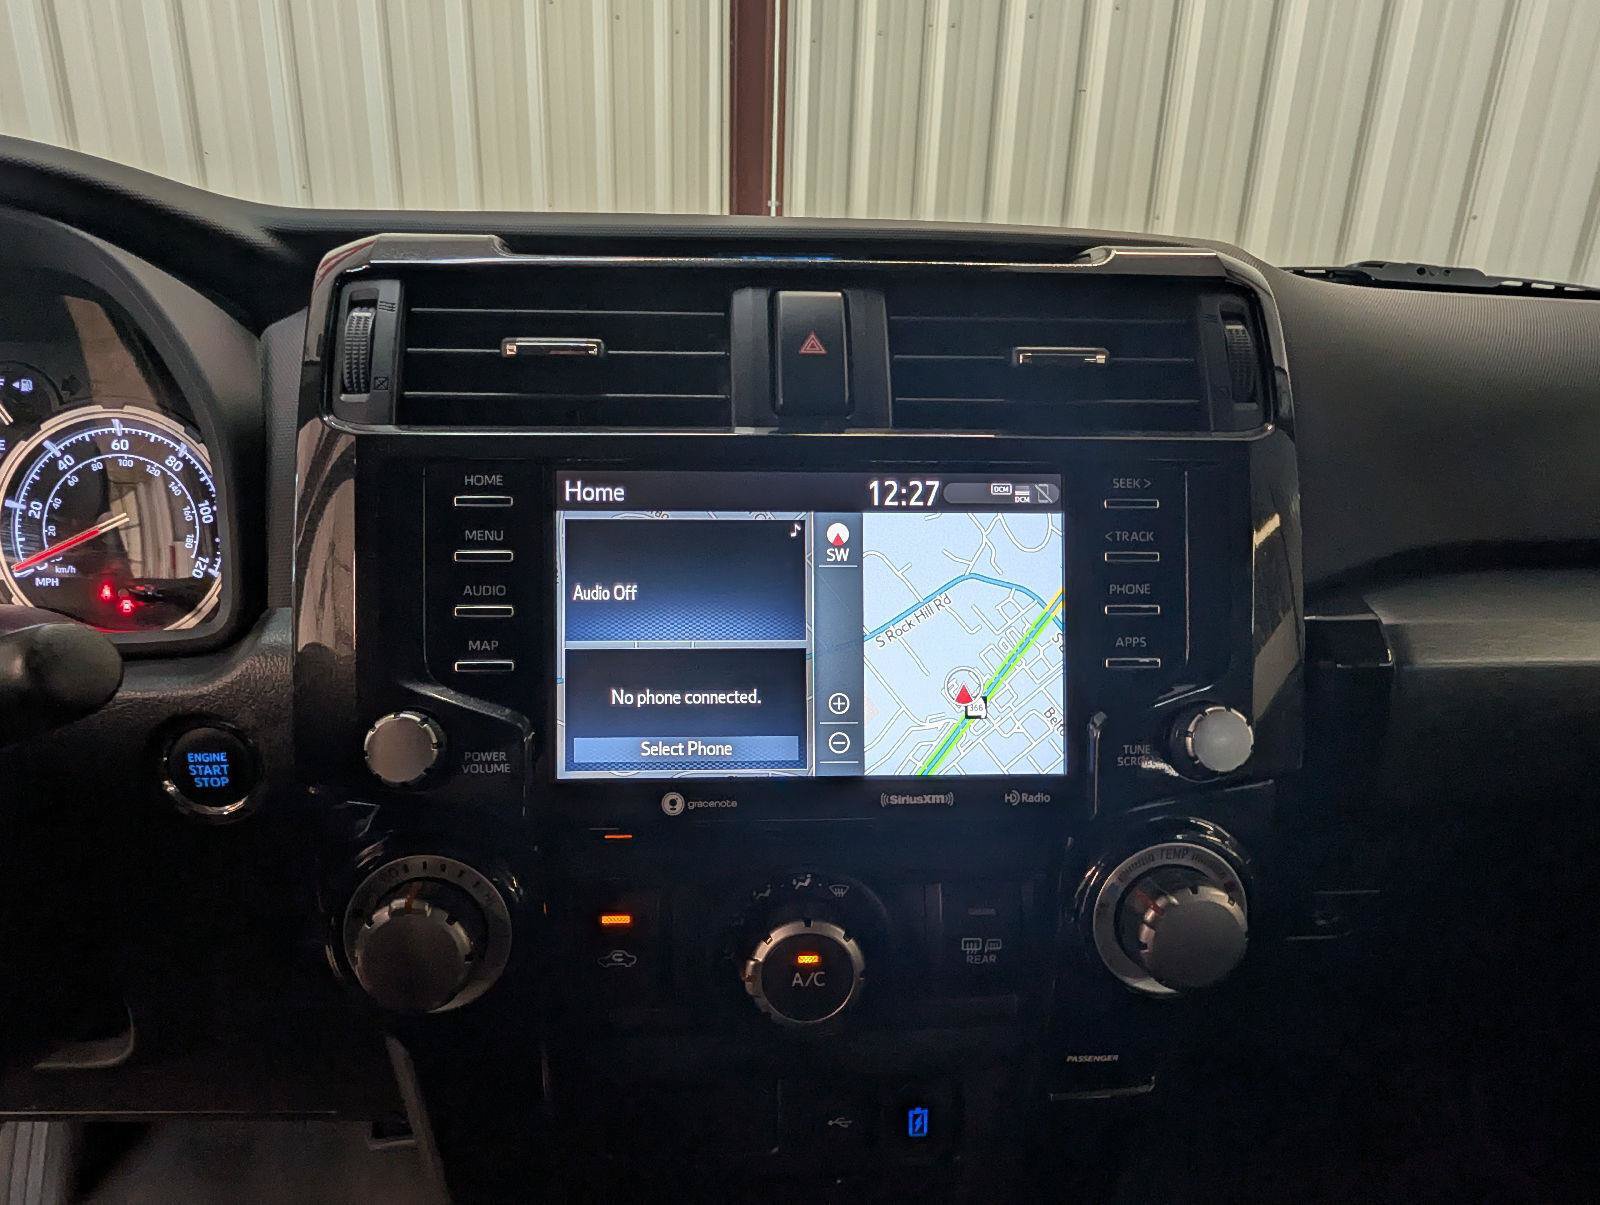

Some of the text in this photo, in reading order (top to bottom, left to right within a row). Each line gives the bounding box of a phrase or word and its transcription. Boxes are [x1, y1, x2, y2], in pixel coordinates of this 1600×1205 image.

[110, 439, 131, 452] 60
[57, 454, 75, 472] 40
[91, 461, 104, 472] 80
[118, 458, 134, 469] 100
[164, 455, 184, 473] 80
[145, 464, 162, 478] 120
[67, 475, 79, 488] 60
[464, 475, 504, 486] HOME
[1112, 478, 1141, 489] SEEK
[168, 480, 182, 497] 140
[564, 480, 625, 503] Home
[868, 480, 940, 507] 12:27
[52, 497, 63, 511] 40
[28, 501, 43, 520] 20
[182, 505, 193, 522] 160
[198, 500, 214, 524] 100
[48, 525, 57, 537] 20
[465, 530, 504, 541] MENU
[1115, 531, 1154, 542] TRACK
[184, 532, 195, 549] 180
[826, 548, 850, 562] SW
[55, 565, 76, 573] km/h
[191, 556, 210, 579] 120
[35, 577, 60, 587] MPH
[463, 585, 506, 596] AUDIO
[573, 585, 637, 600] Audio Off
[1109, 583, 1151, 595] PHONE
[875, 593, 952, 648] S Rock Hill Rd
[468, 640, 499, 651] MAP
[1115, 637, 1147, 647] APPS
[611, 689, 762, 707] No phone connected.
[968, 703, 984, 712] 366
[641, 741, 732, 756] Select Phone
[1123, 744, 1151, 755] TUNE
[187, 752, 228, 763] ENGINE
[464, 751, 507, 762] POWER
[188, 764, 230, 776] START
[462, 763, 511, 774] VOLUME
[194, 777, 230, 788] STOP
[1021, 792, 1051, 804] Radio
[687, 799, 738, 810] gracenote
[966, 955, 997, 965] REAR
[792, 971, 826, 988] A/C
[1066, 1054, 1119, 1063] PASSENGER
